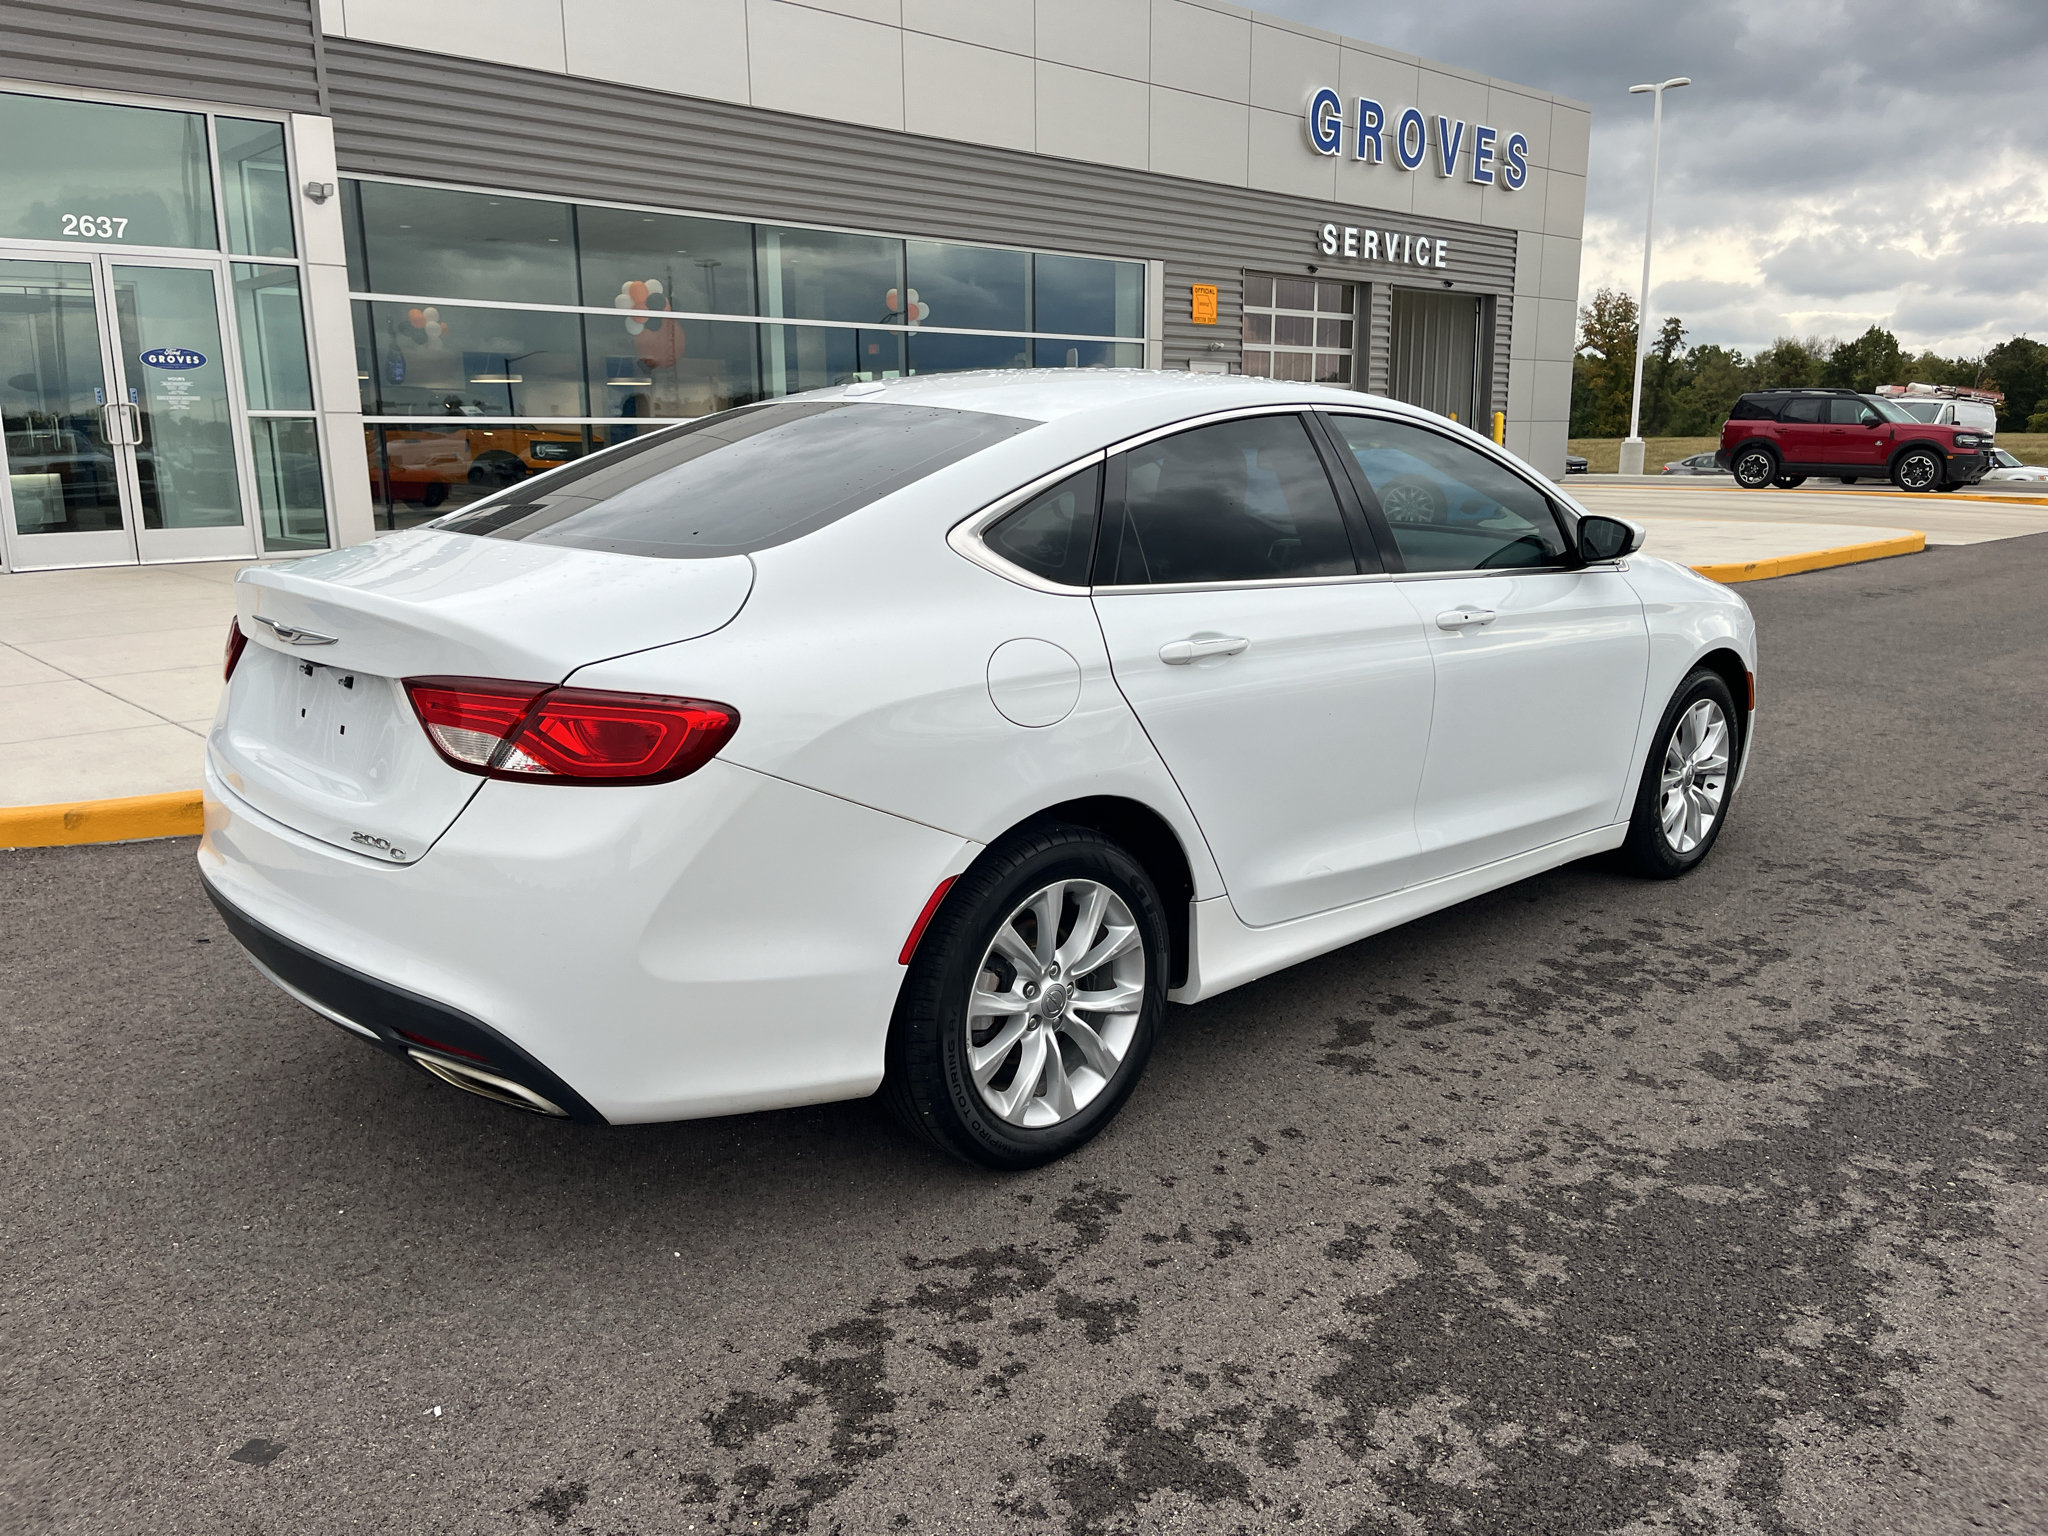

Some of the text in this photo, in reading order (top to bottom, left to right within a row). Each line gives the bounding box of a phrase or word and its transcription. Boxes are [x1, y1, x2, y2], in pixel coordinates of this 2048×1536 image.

[1306, 86, 1529, 191] GROVES
[61, 213, 129, 239] 2637
[1321, 223, 1448, 269] SERVICE
[148, 354, 200, 364] GROVES
[350, 831, 407, 861] 200 C
[946, 1038, 972, 1119] TOURING
